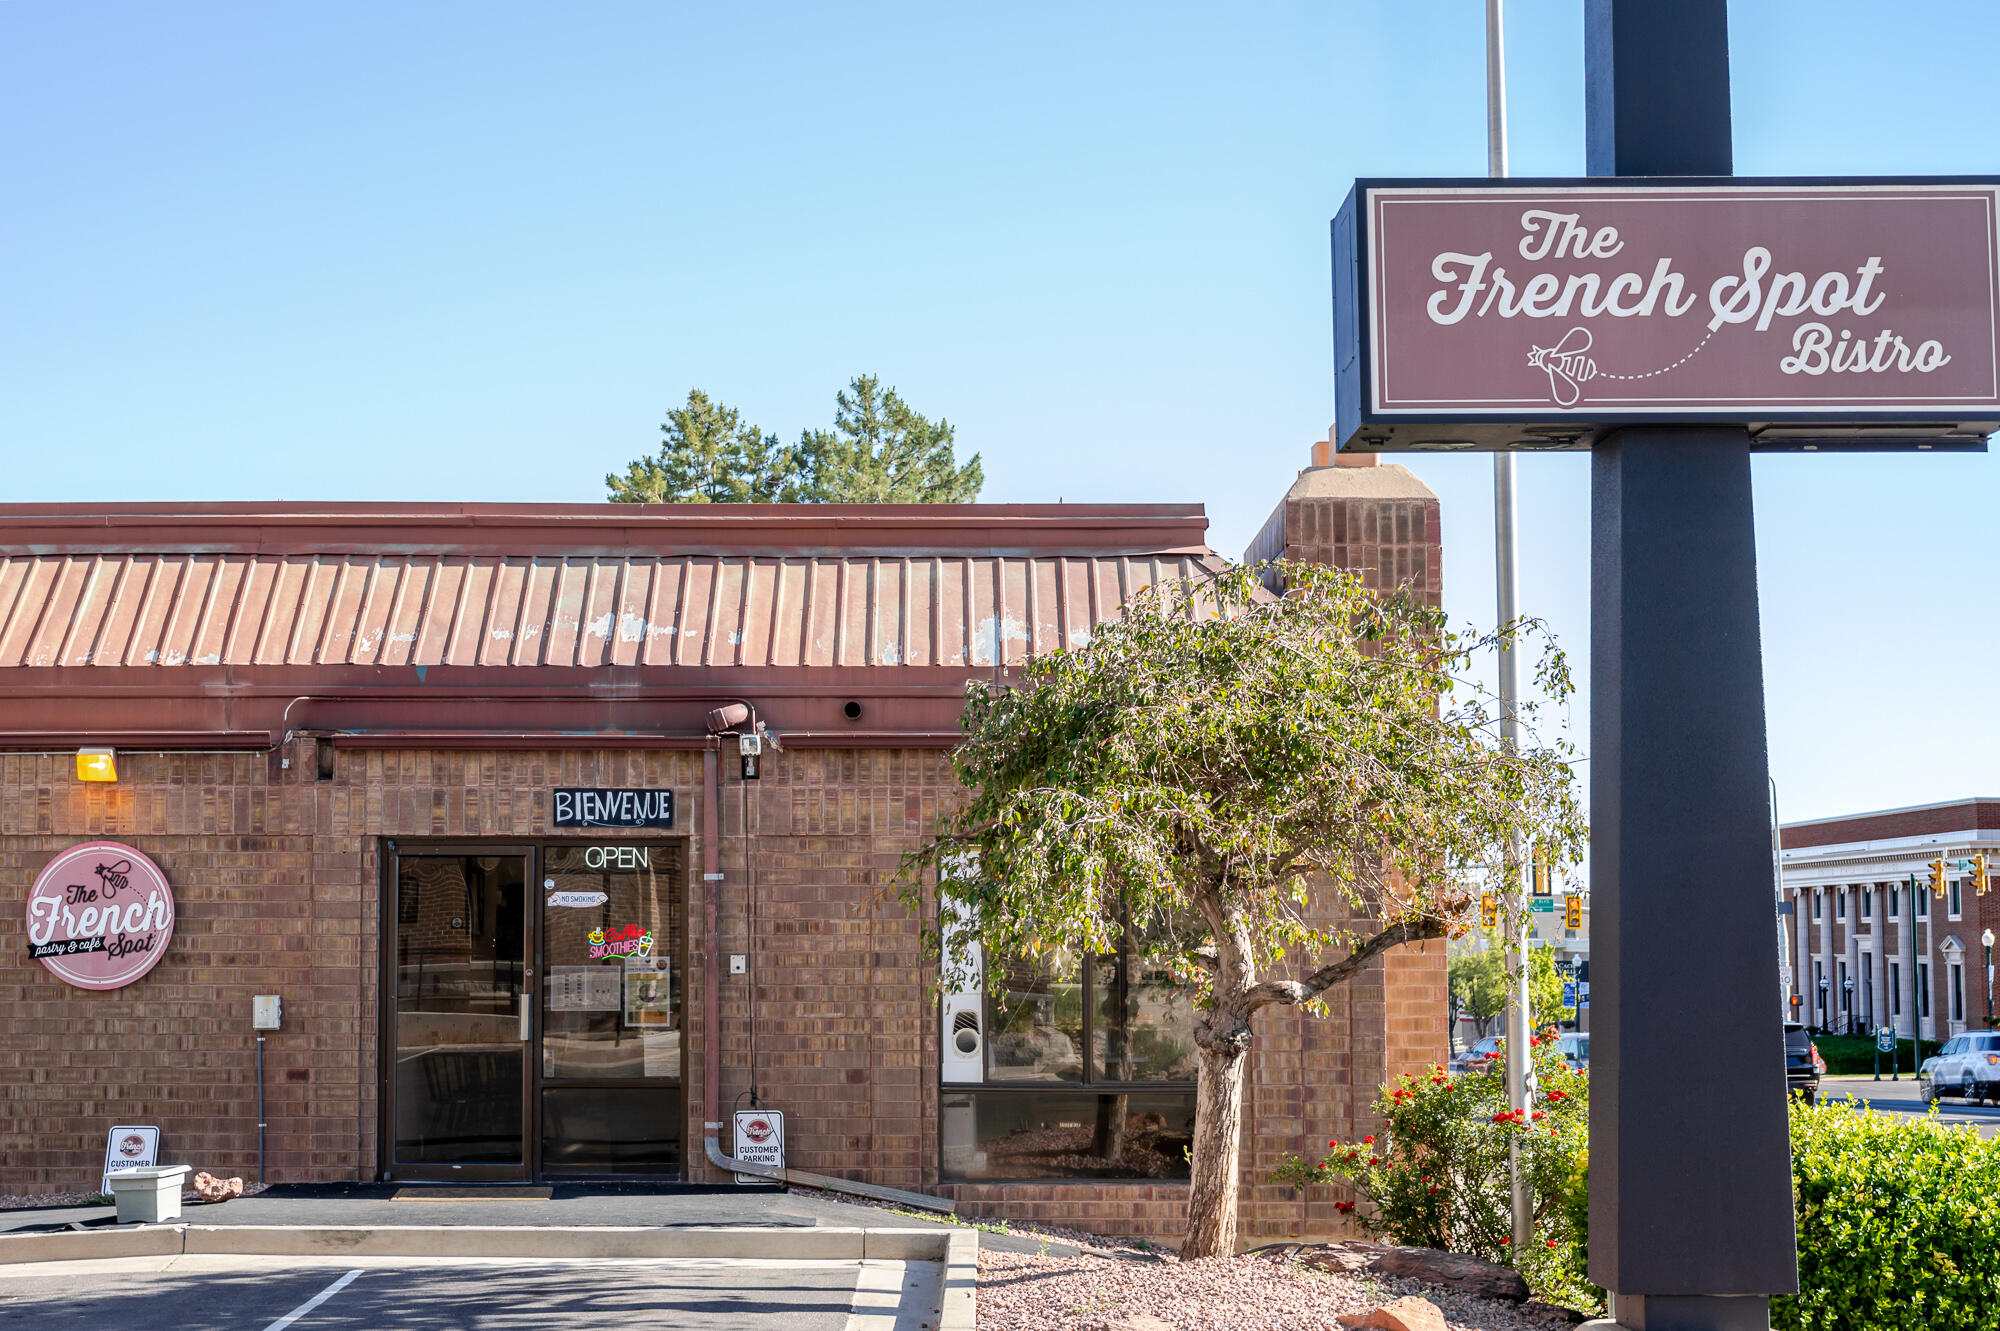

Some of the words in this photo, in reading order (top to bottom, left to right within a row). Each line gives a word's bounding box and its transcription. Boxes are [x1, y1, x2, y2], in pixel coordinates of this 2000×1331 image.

[1518, 209, 1624, 261] The
[1426, 251, 1697, 326] French
[1707, 246, 1887, 332] Spot
[1780, 322, 1952, 376] Bistro
[554, 791, 670, 822] BIENVENUE
[585, 846, 648, 868] OPEN
[66, 884, 98, 905] The
[561, 895, 570, 903] NO
[570, 895, 596, 903] SMOKING
[30, 890, 172, 946] French
[604, 924, 647, 942] Coffee
[35, 943, 67, 957] pastry
[67, 941, 78, 952] &
[79, 937, 101, 952] café
[108, 933, 156, 960] Spot
[589, 939, 639, 959] SMOOTHIES
[740, 1146, 779, 1154] CUSTOMER
[743, 1154, 776, 1163] PARKING
[110, 1160, 151, 1168] CUSTOMER
